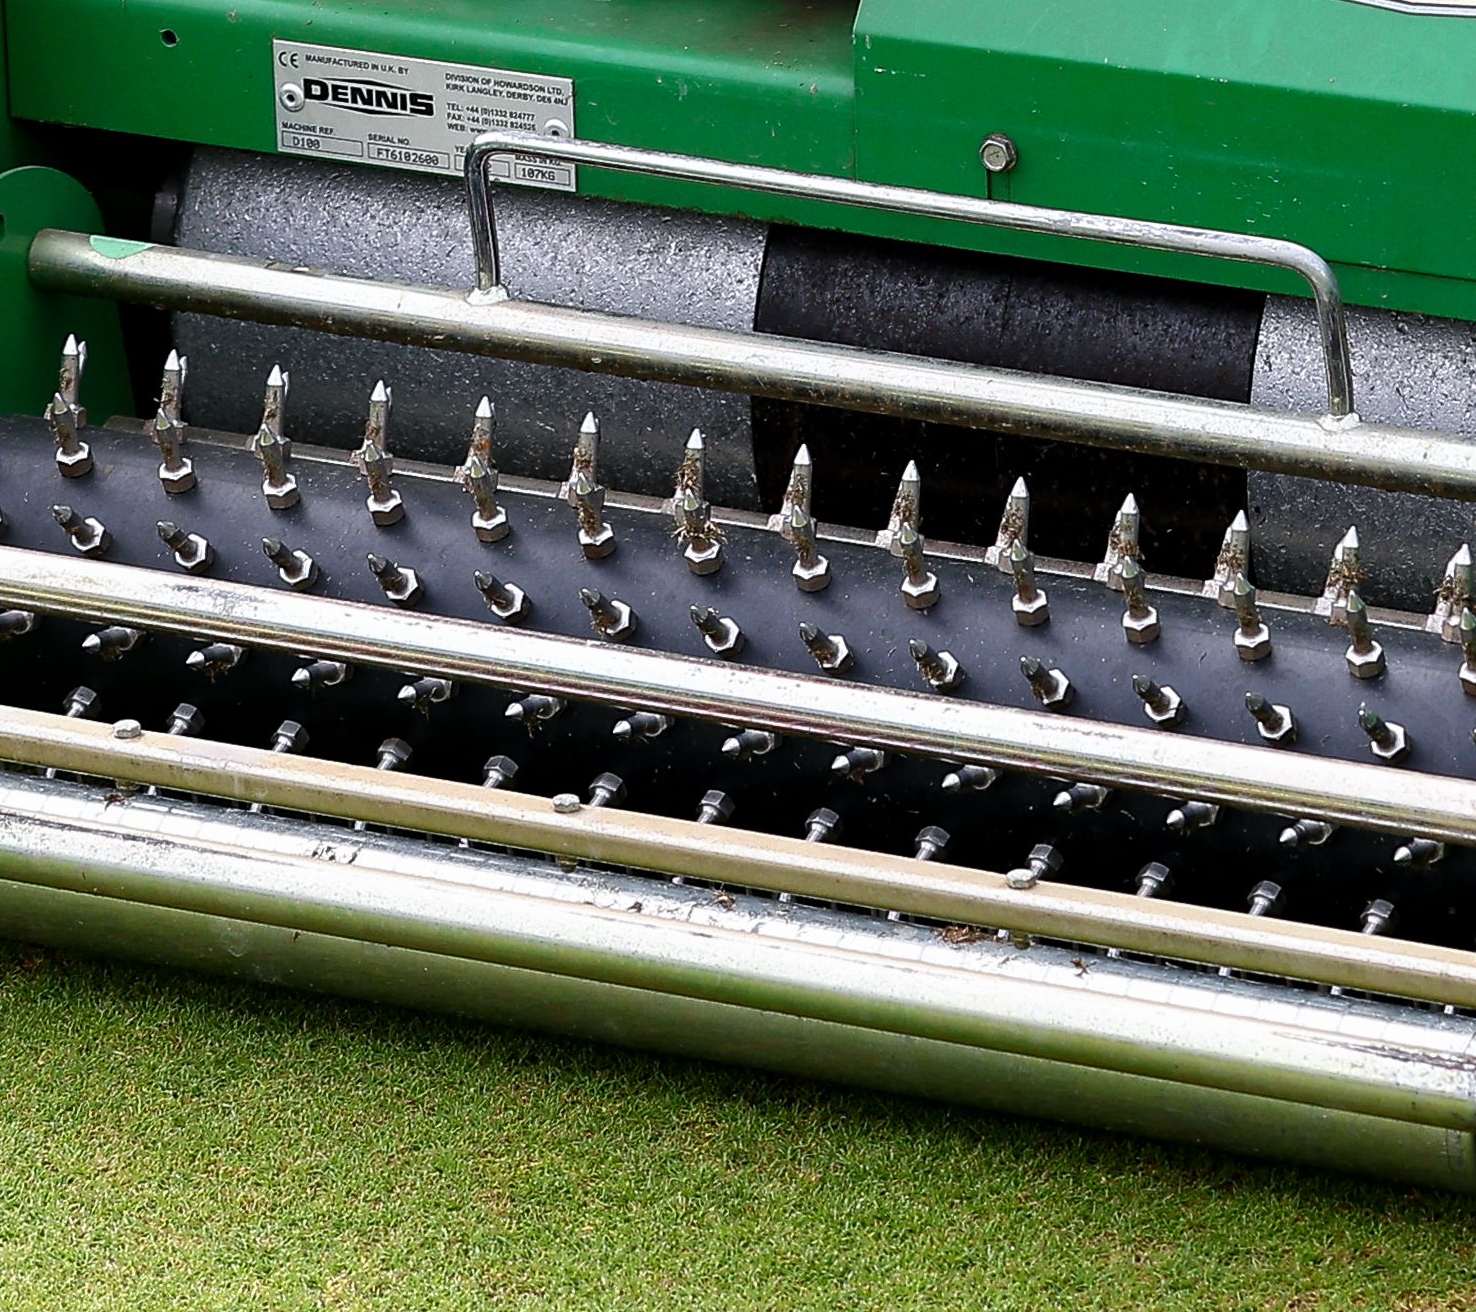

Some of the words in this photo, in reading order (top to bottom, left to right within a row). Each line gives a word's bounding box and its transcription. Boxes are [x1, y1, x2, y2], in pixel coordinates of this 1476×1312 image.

[306, 54, 370, 70] MANUFACTURED
[371, 63, 379, 71] IN
[398, 66, 409, 75] BY
[445, 73, 479, 85] DIVISION
[481, 77, 492, 85] OF
[494, 79, 545, 94] HOWARDSON
[446, 83, 464, 93] KIRK
[303, 78, 434, 116] DENNIS
[466, 106, 479, 114] +44
[467, 115, 480, 124] +44
[282, 121, 317, 134] MACHINE
[292, 136, 321, 149] D100
[368, 133, 396, 145] SERIAL
[377, 148, 439, 166] FT6102600
[522, 168, 556, 181] 107KG
